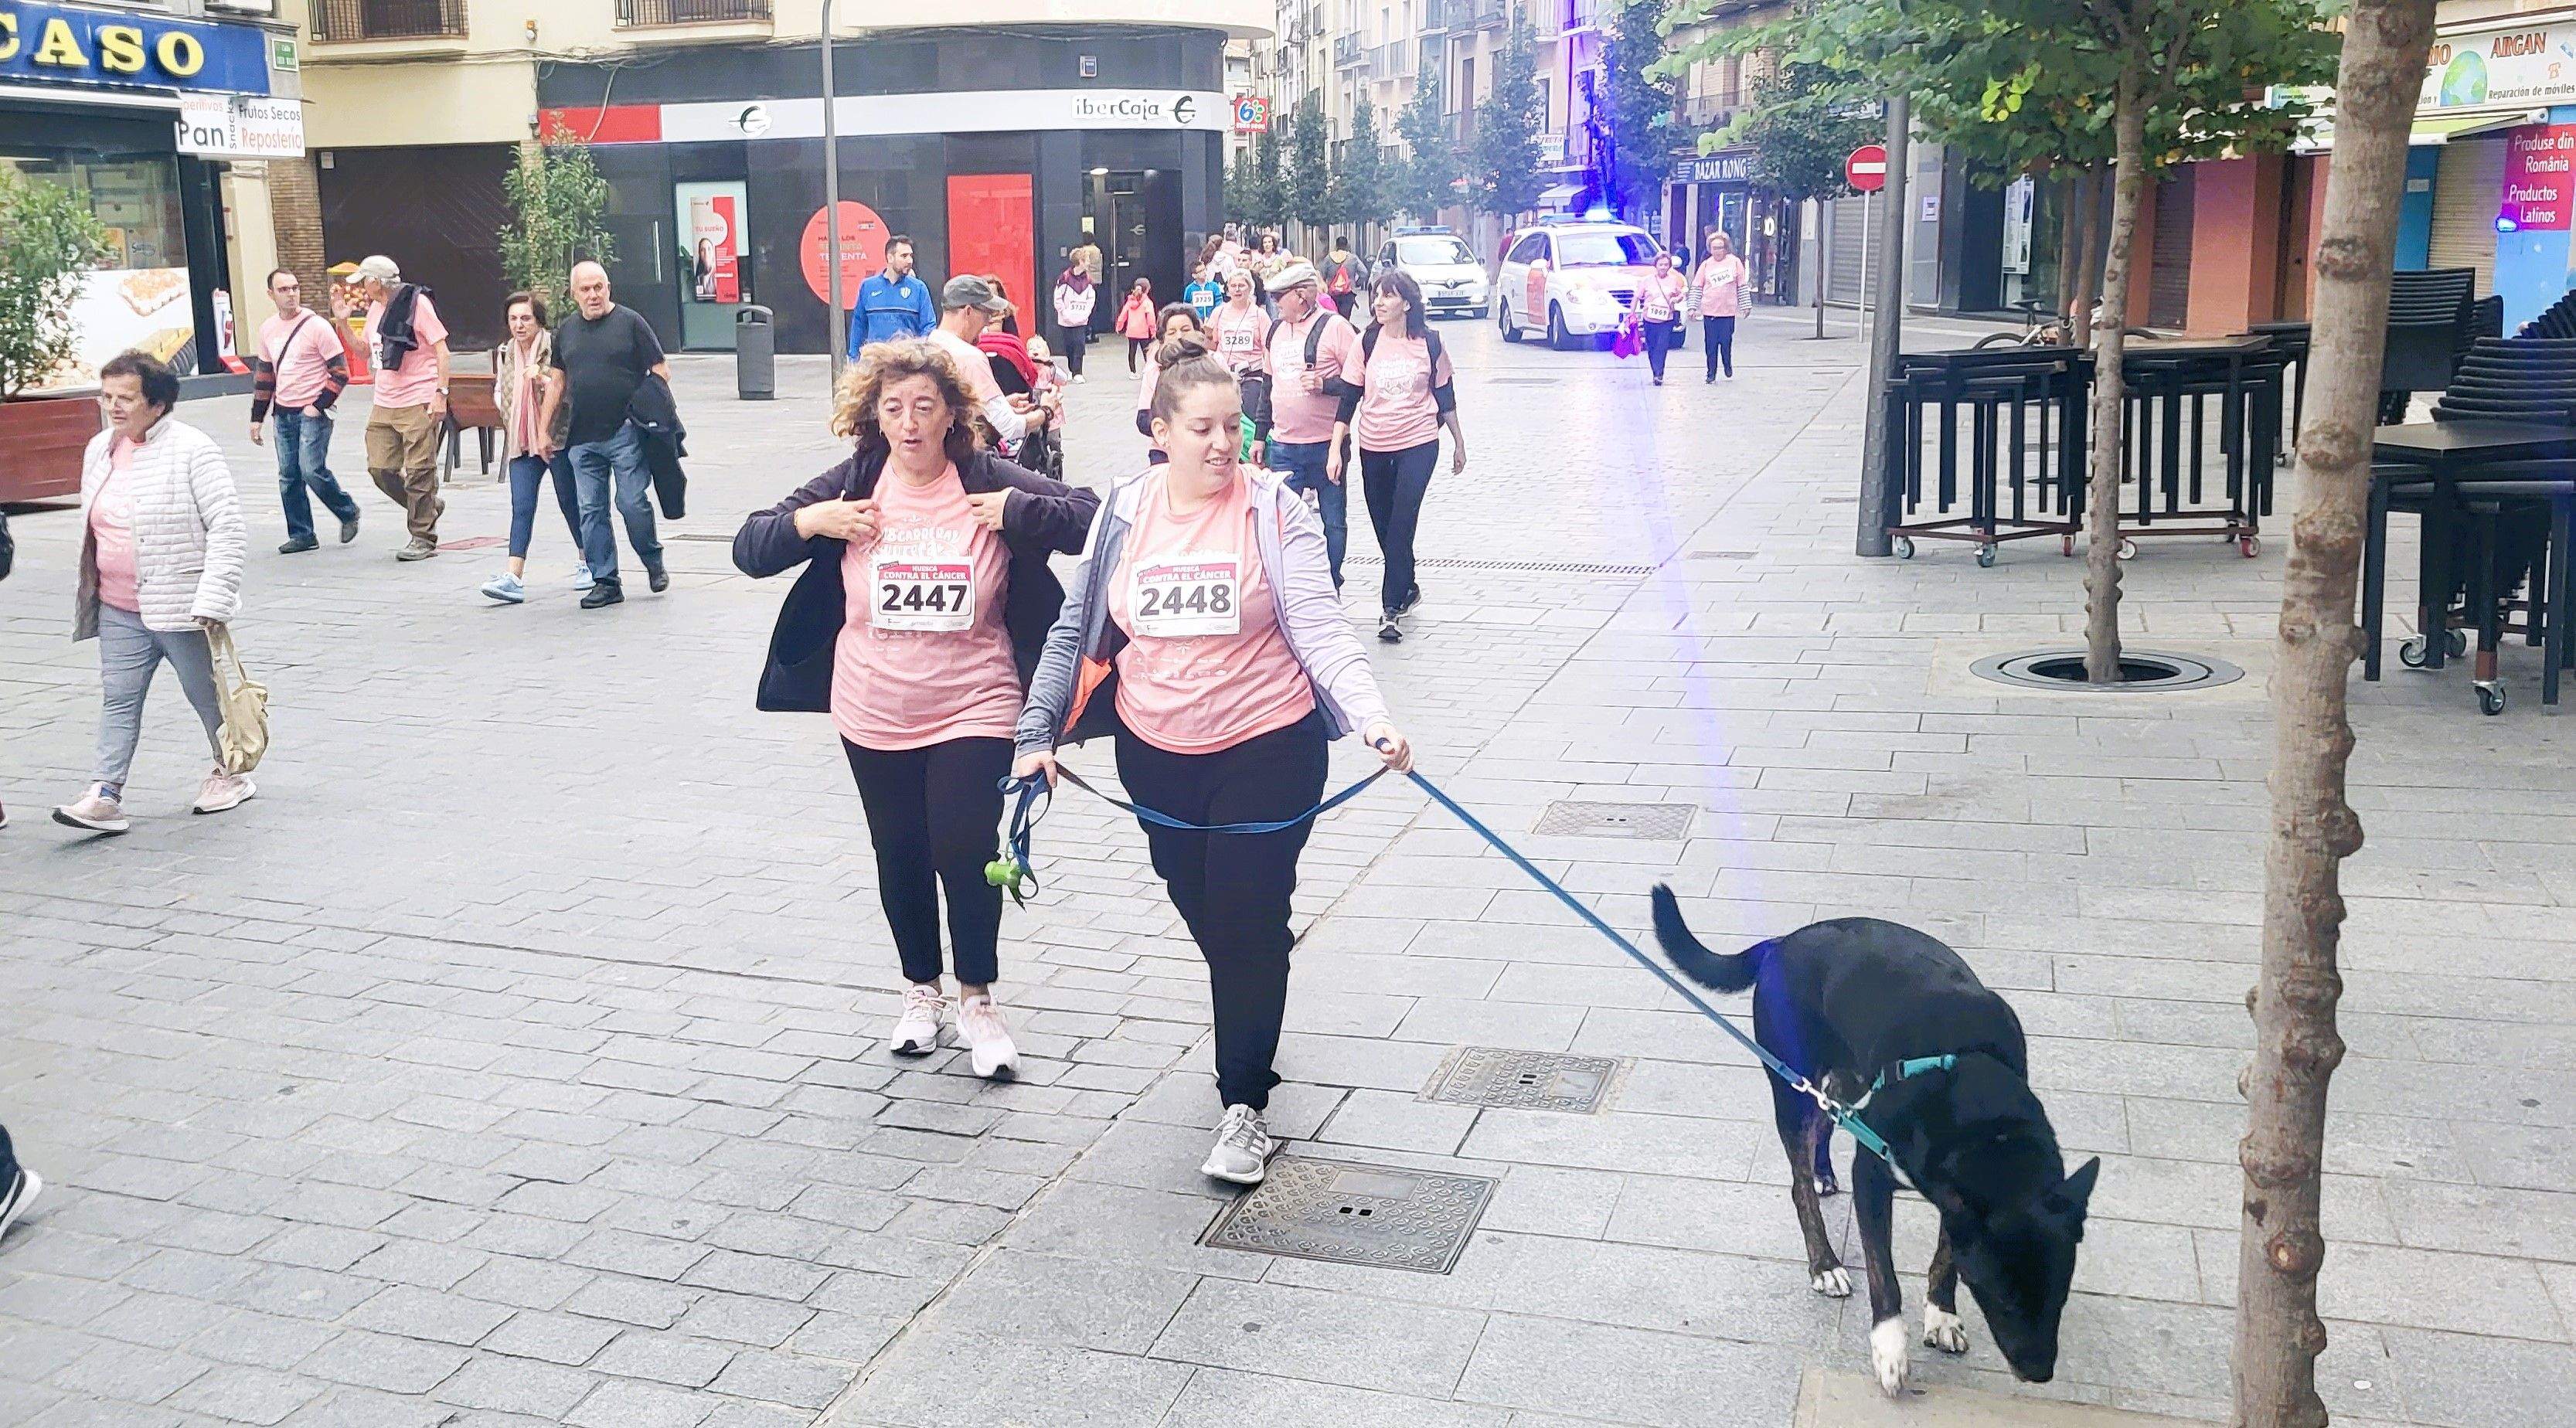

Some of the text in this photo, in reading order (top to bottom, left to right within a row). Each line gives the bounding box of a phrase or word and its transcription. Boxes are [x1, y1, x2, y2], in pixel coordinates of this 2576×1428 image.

[2489, 32, 2547, 60] ARGAN
[2533, 85, 2541, 96] de
[2544, 83, 2575, 95] móviles
[238, 104, 301, 121] Frutos Secos
[179, 121, 224, 147] Pan
[2514, 131, 2574, 152] Produse din
[1695, 157, 1747, 181] BAZAR RONG
[2525, 154, 2569, 174] România
[2509, 182, 2557, 202] Productos
[2520, 205, 2556, 223] Latinos
[1225, 335, 1251, 345] 3289
[933, 570, 967, 580] CÁNCER
[1142, 570, 1231, 583] CONTRA EL CÁNCER
[882, 584, 968, 611] 2447
[1139, 584, 1231, 617] 2448
